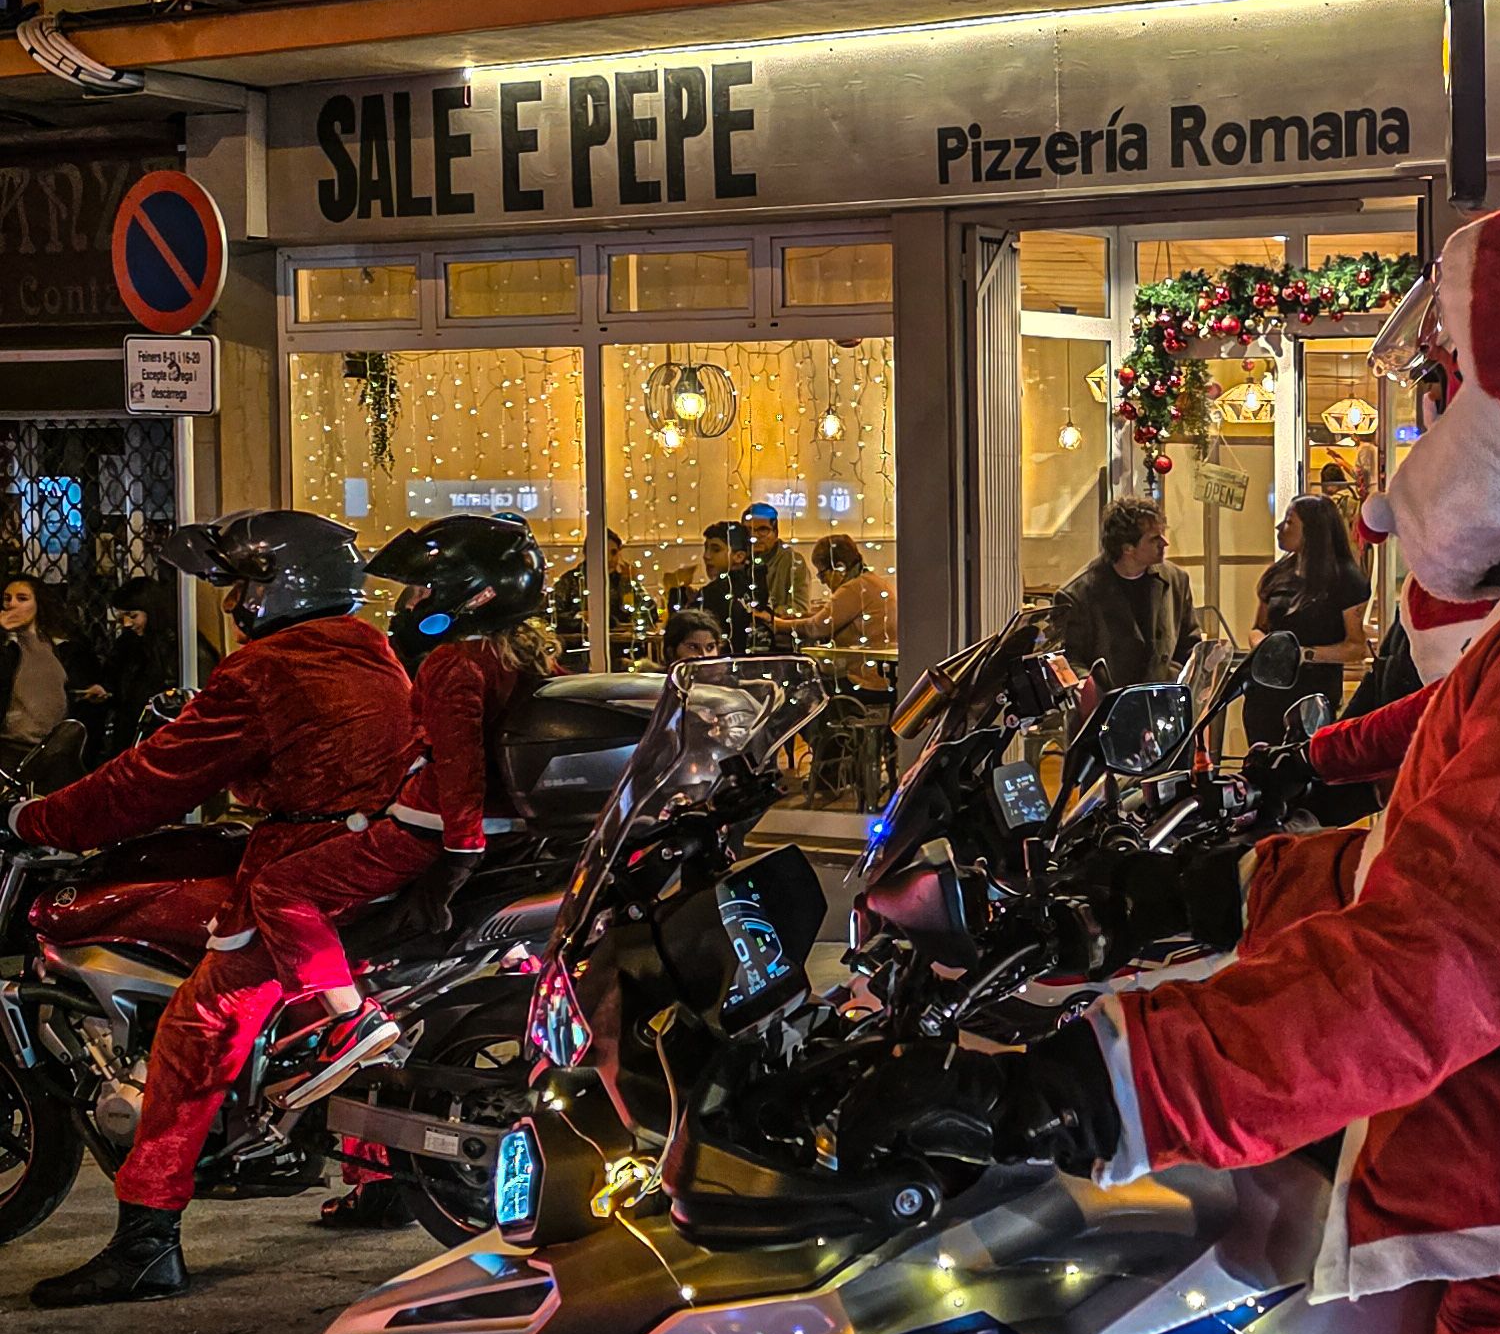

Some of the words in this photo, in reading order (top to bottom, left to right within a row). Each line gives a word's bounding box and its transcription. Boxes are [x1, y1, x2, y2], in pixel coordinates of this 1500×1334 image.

[316, 85, 476, 224] SALE
[499, 80, 545, 213] E
[569, 60, 758, 209] PEPE
[936, 105, 1149, 185] Pizzería
[1170, 104, 1410, 168] Romana
[1204, 480, 1235, 505] OPEN
